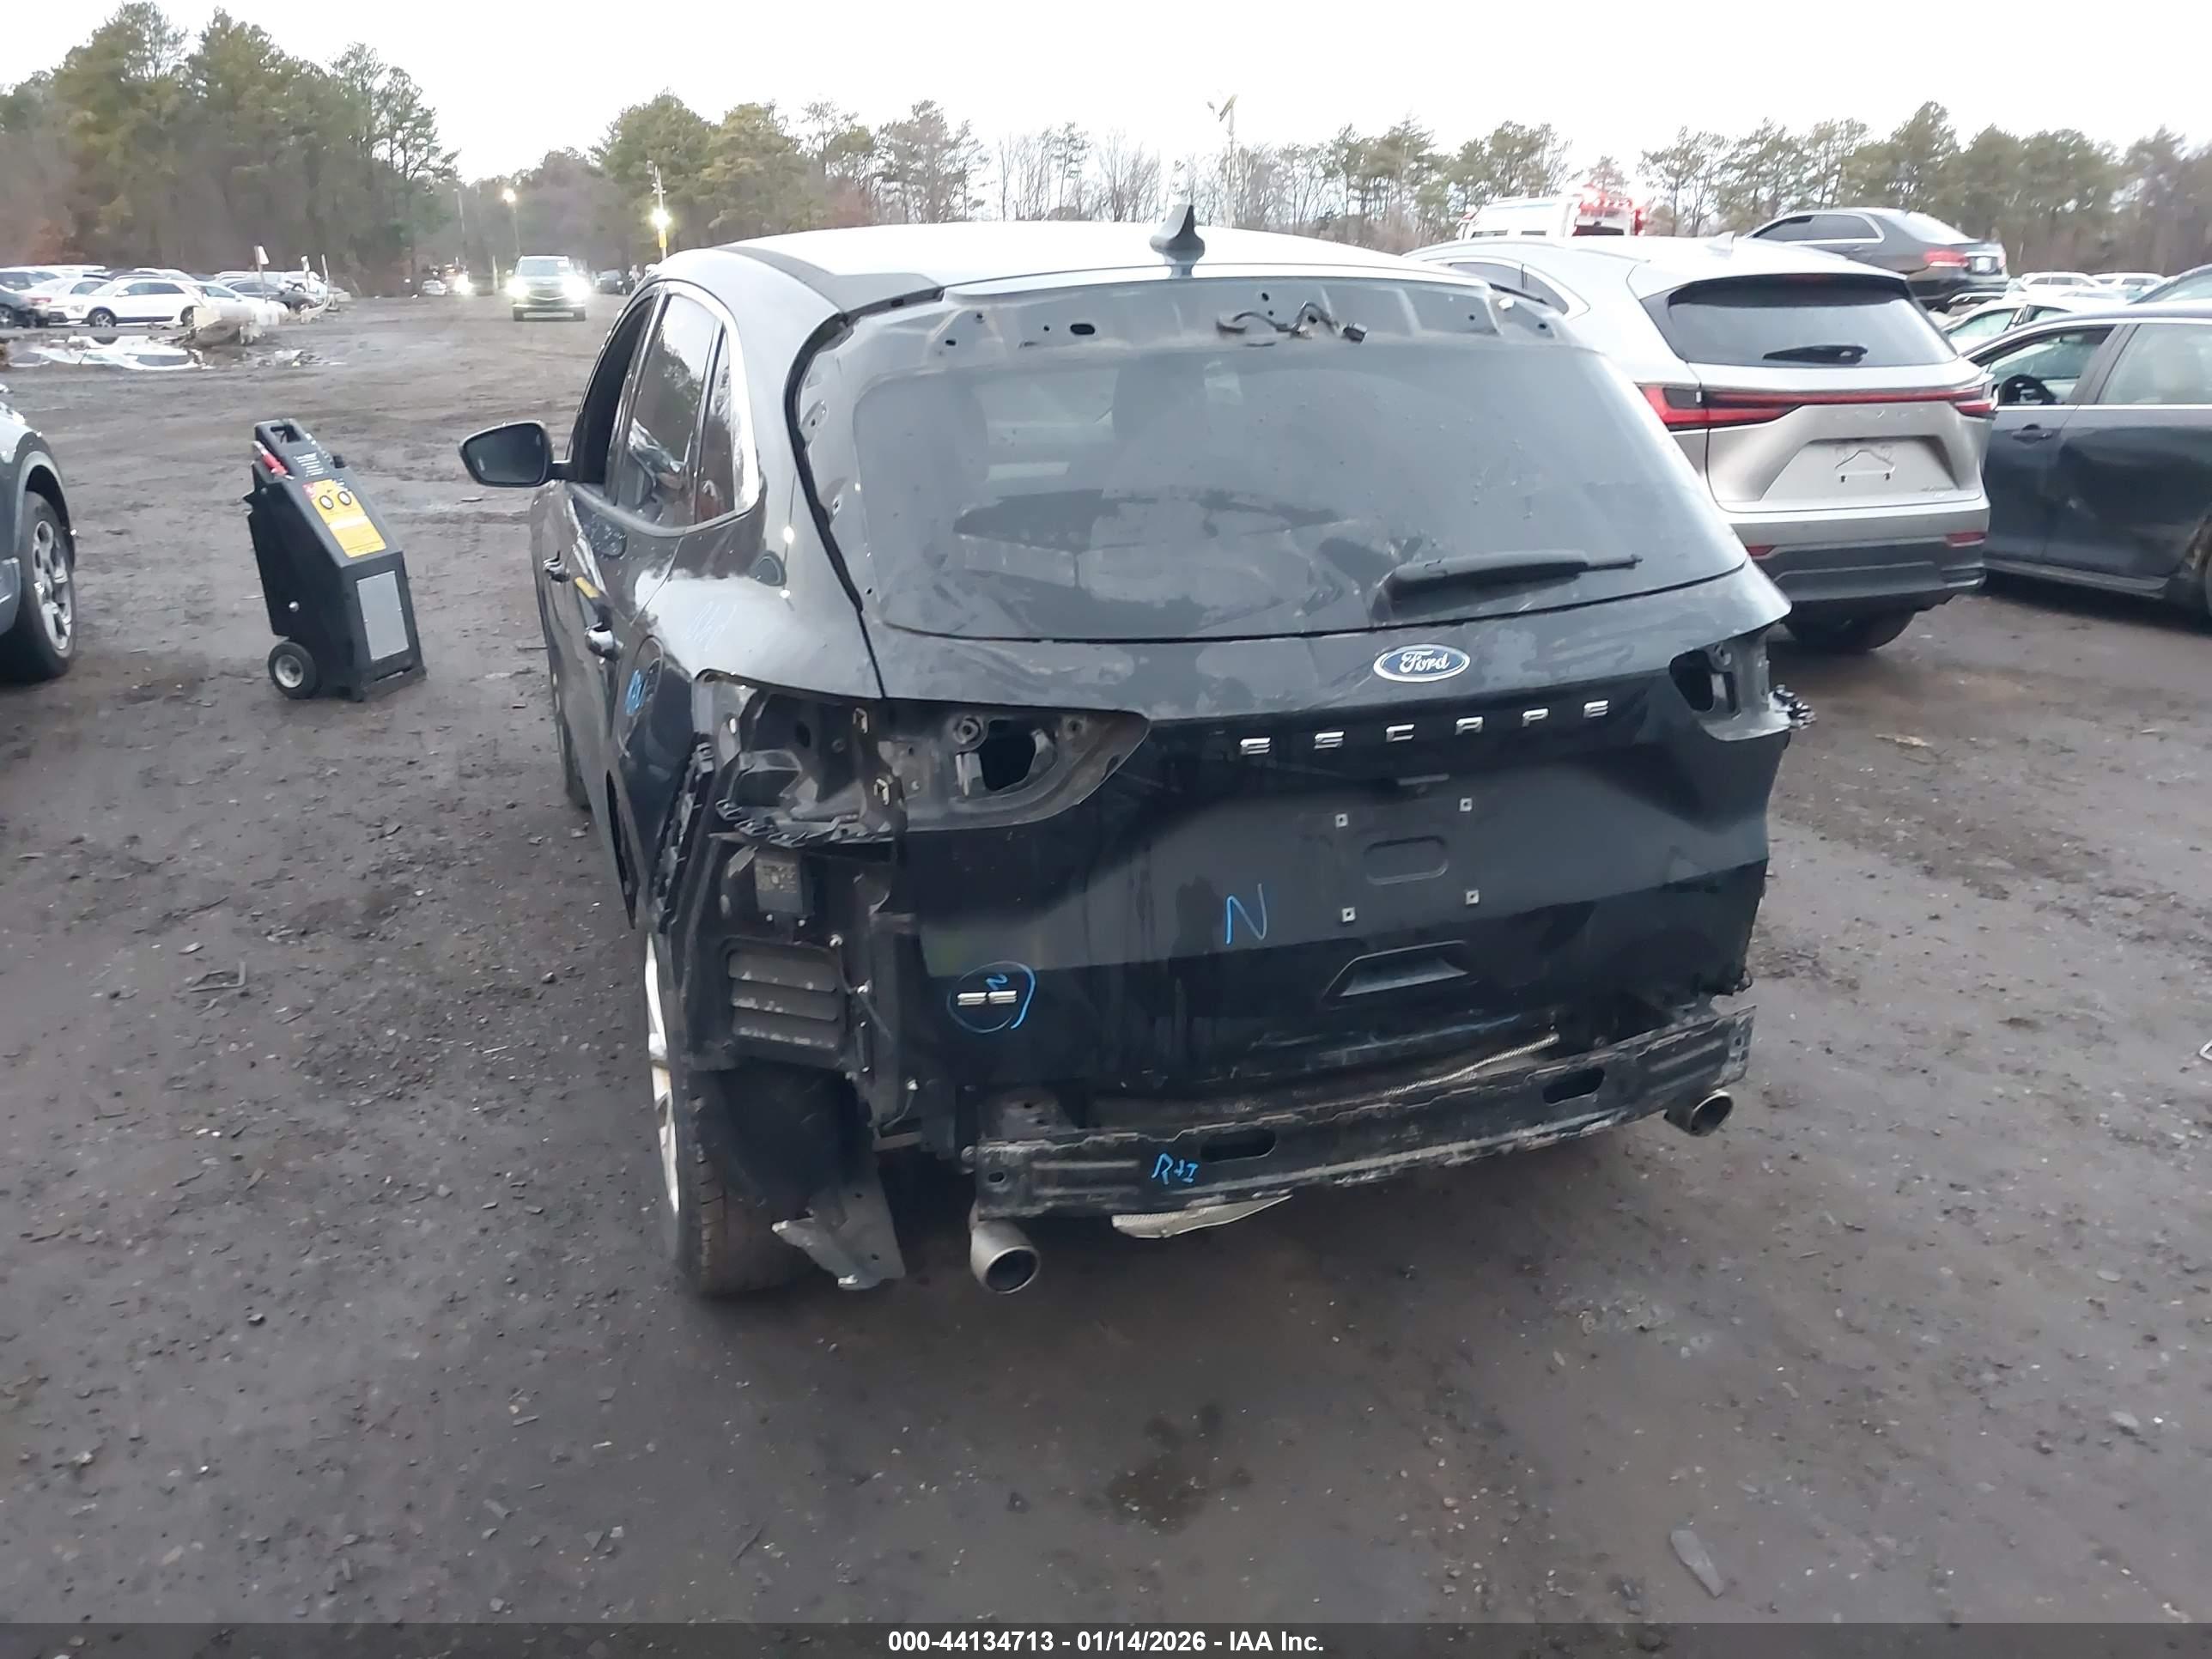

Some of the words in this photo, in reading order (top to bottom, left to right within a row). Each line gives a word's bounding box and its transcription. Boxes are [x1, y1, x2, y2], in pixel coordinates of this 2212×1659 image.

[1399, 649, 1450, 673] Ford
[1239, 700, 1610, 757] ESCAPE
[1225, 882, 1268, 945] N
